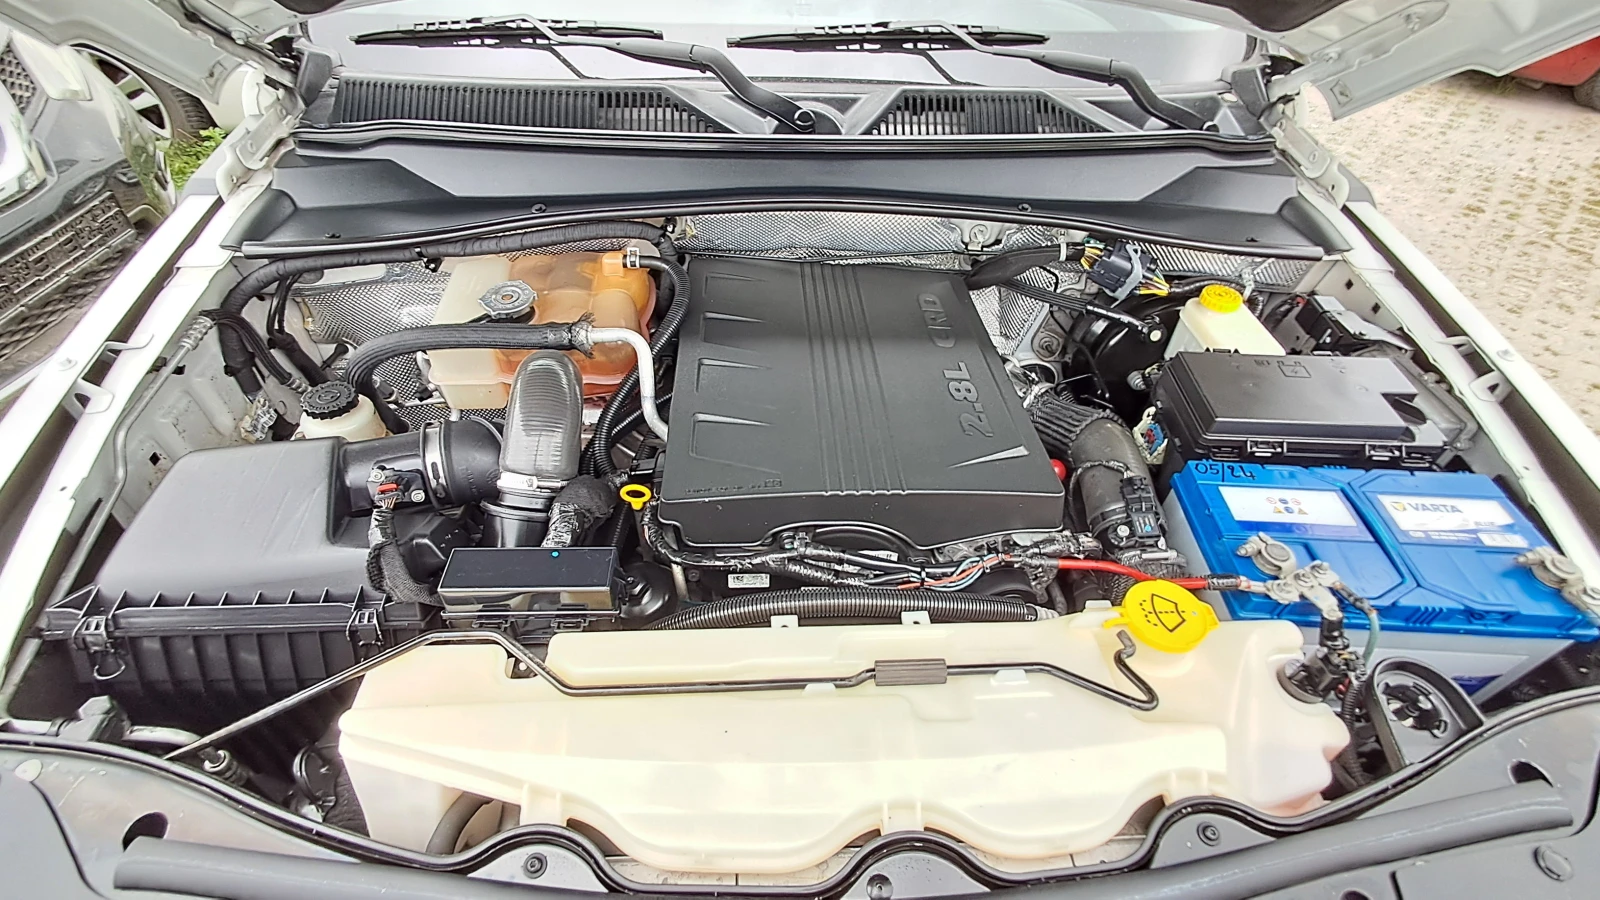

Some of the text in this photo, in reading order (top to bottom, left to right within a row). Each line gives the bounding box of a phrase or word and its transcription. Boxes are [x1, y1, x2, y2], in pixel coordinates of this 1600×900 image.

[918, 292, 994, 438] 2.8L CRD
[1194, 462, 1257, 483] 05/24
[1407, 502, 1463, 514] VARTA
